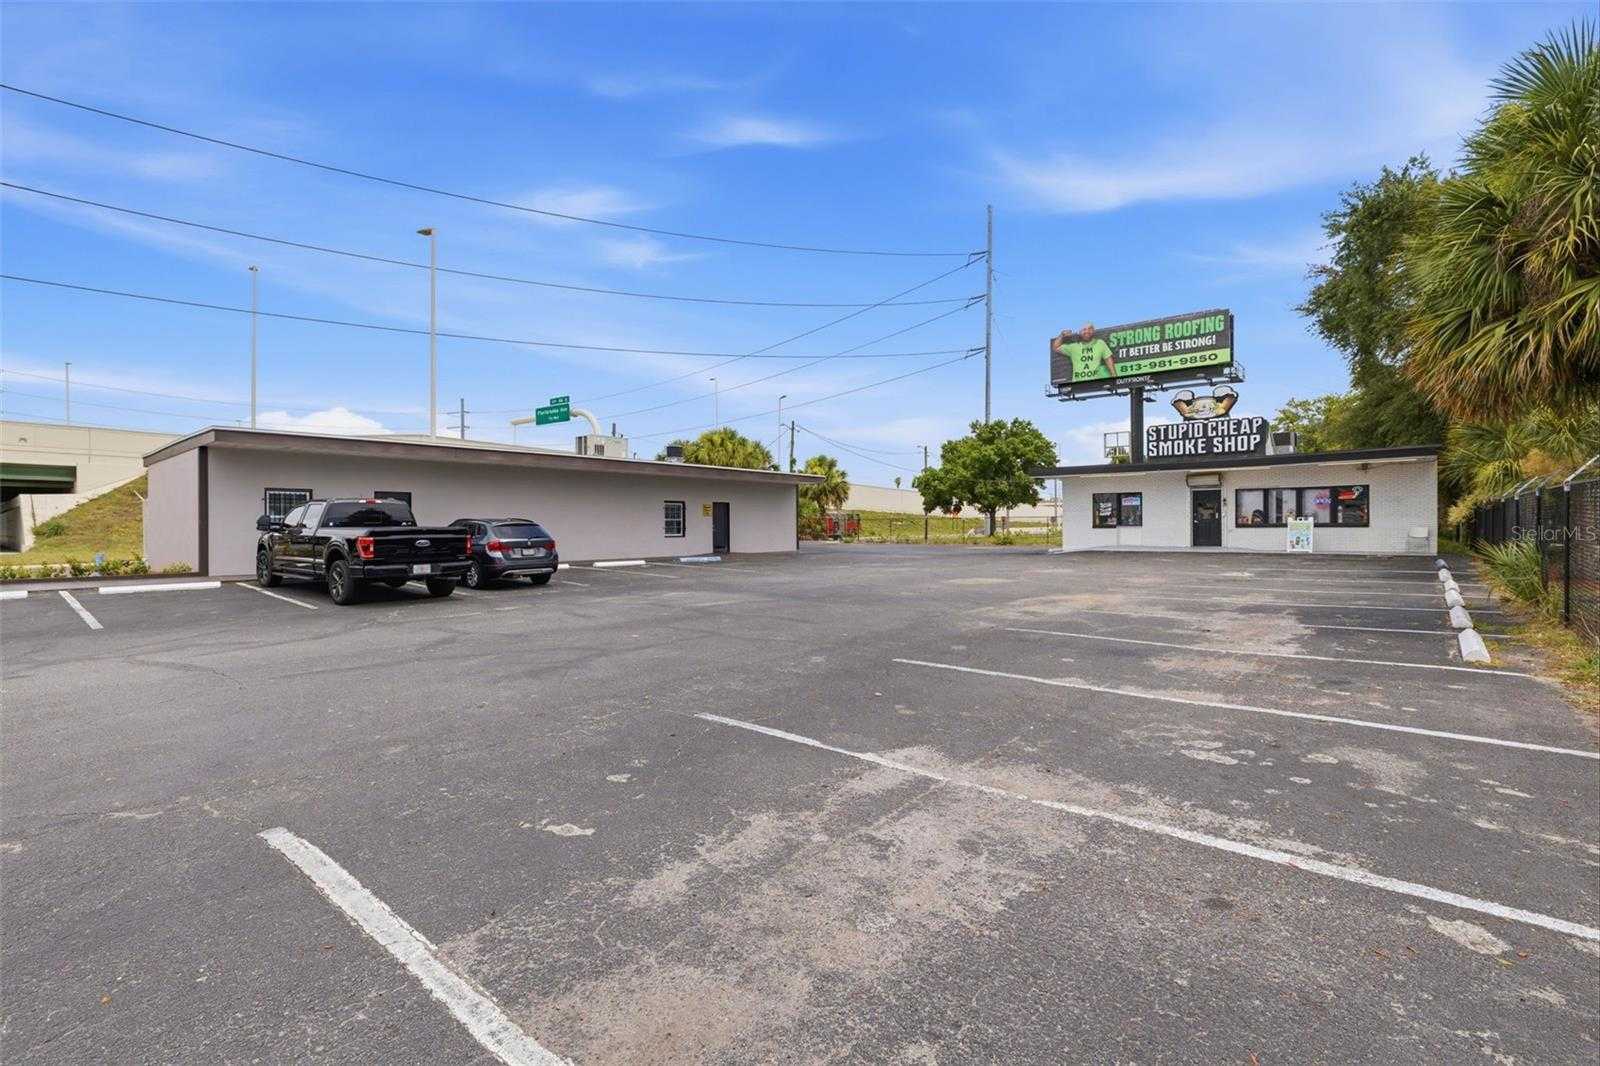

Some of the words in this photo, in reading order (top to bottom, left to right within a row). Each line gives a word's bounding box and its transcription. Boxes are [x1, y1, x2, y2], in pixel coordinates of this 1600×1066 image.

[1109, 326, 1161, 348] STRONG
[1165, 314, 1225, 339] ROOFING
[1119, 348, 1128, 358] IT
[1129, 343, 1160, 357] BETTER
[1162, 341, 1174, 352] BE
[1174, 334, 1217, 350] STRONG!
[1119, 352, 1218, 373] 813-981-9850
[1148, 422, 1203, 440] STUPID
[1207, 417, 1263, 438] CHEAP
[1148, 438, 1207, 457] SMOKE
[1212, 434, 1261, 454] SHOP
